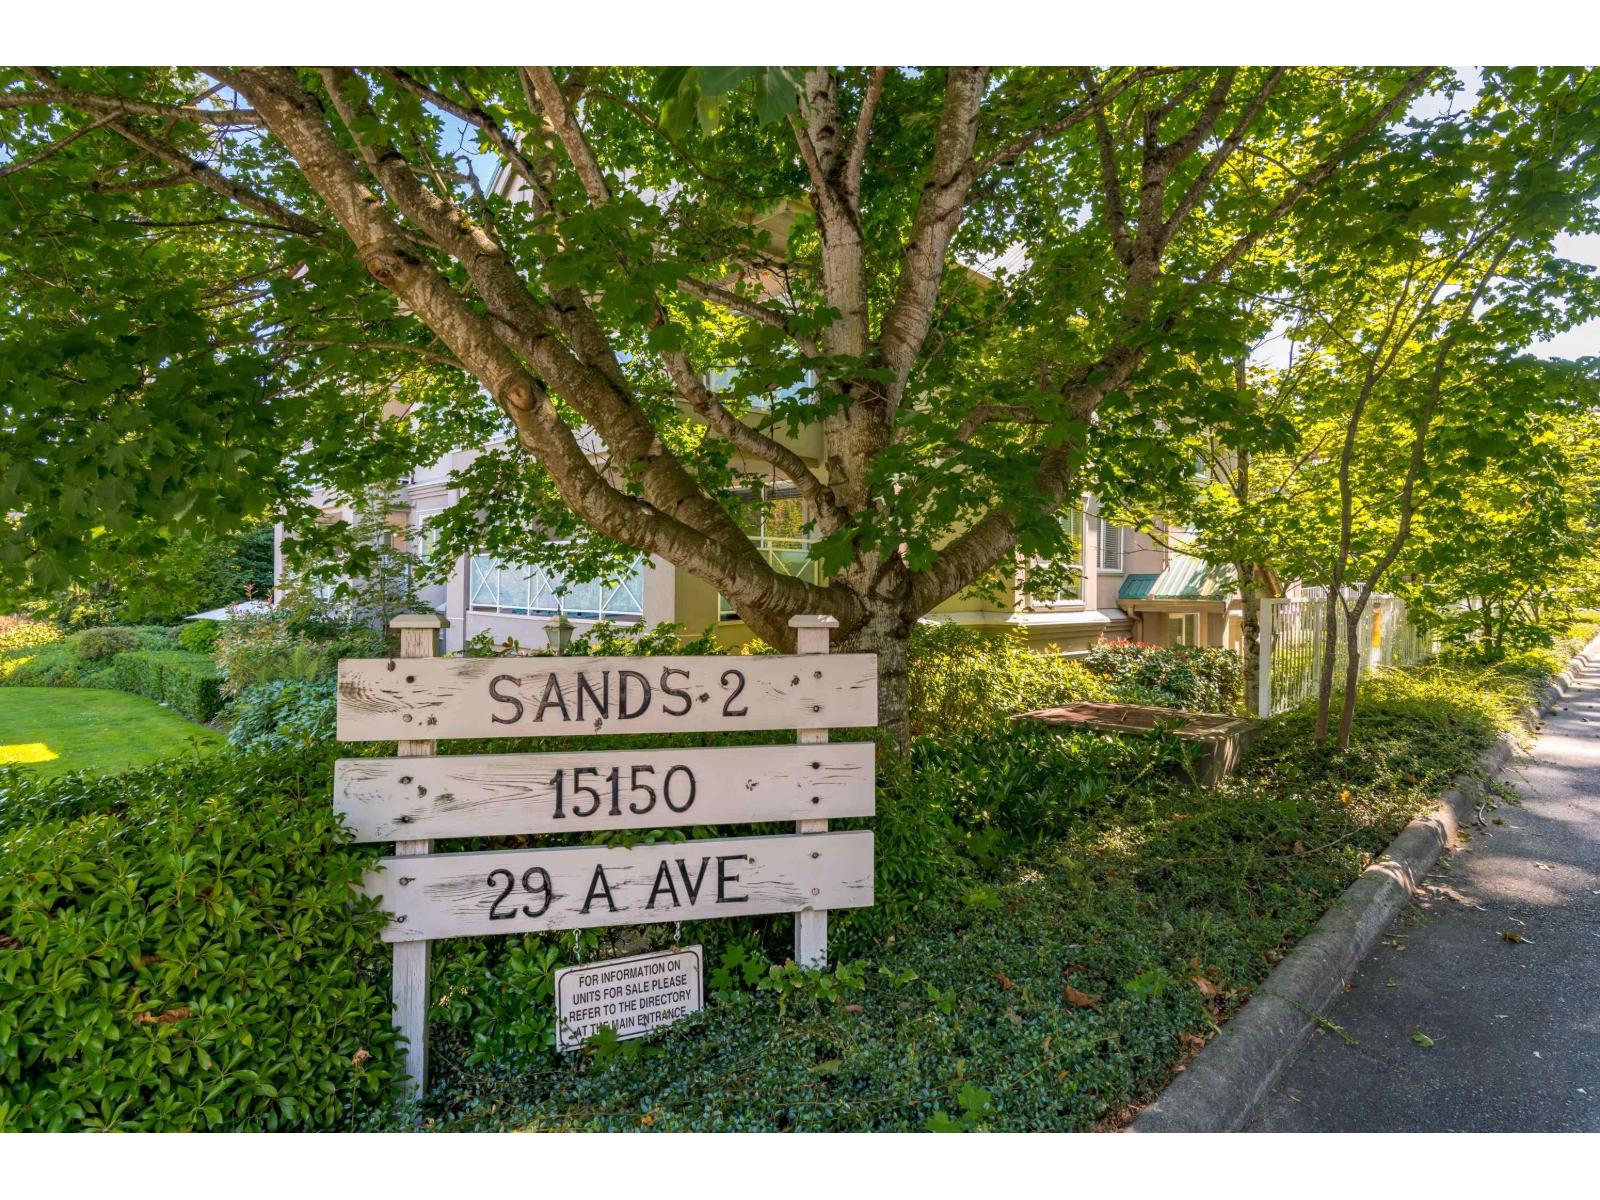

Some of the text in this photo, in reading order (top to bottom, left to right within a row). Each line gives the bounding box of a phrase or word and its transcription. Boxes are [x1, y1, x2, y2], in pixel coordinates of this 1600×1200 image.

[490, 669, 748, 724] SANDS 2
[551, 765, 697, 819] 15150
[487, 854, 749, 920] 29 A AVE
[573, 974, 687, 1005] UNITS FOR SALE PLEASE
[579, 960, 681, 988] FOR INFORMATION ON
[569, 989, 691, 1023] REFER TO THE DIRECTORY
[575, 1006, 686, 1038] AT TH MAIN ENTRANCE
